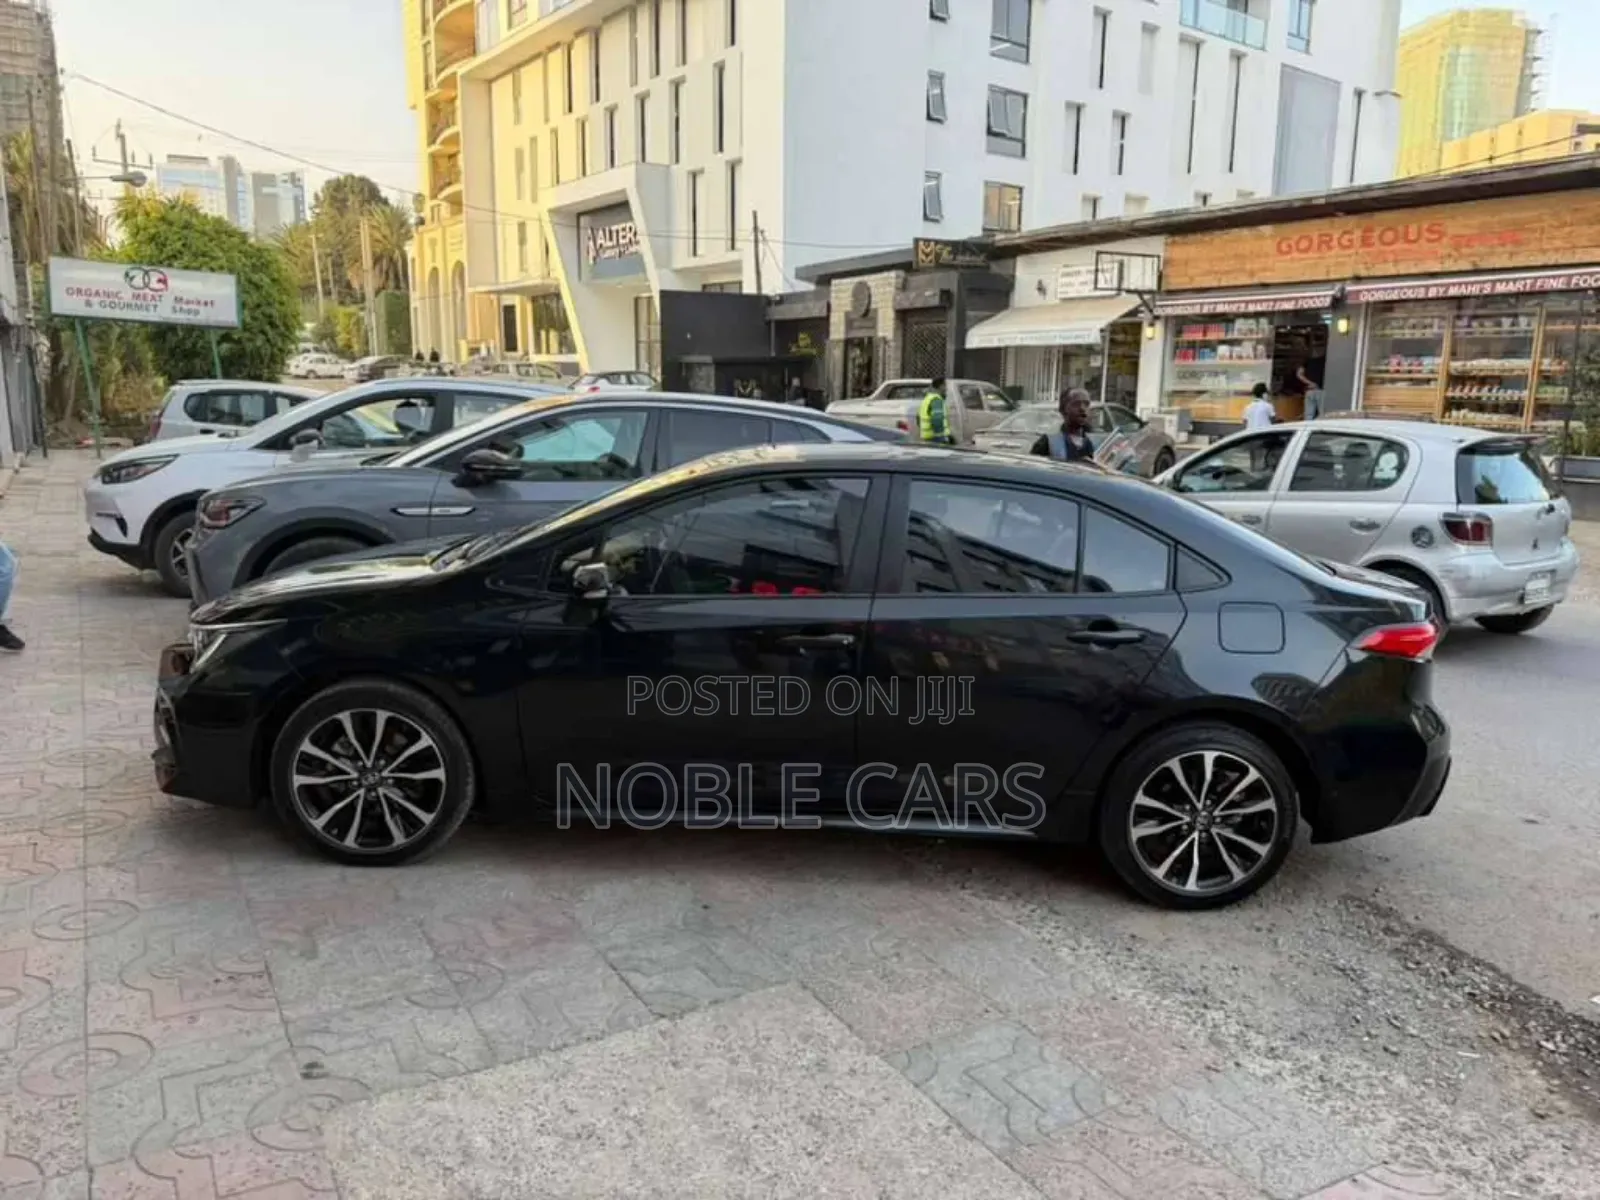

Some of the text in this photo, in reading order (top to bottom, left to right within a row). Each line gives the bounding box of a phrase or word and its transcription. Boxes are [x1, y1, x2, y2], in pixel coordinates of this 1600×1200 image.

[1276, 223, 1447, 256] GORGEOUS
[65, 287, 215, 308] ORGANIC MEAT Market
[1360, 287, 1425, 300] GORGEOUS
[1427, 285, 1446, 297] BY
[1448, 281, 1491, 296] MAHI'S
[1495, 278, 1533, 293] MART
[1535, 275, 1567, 290] FINE
[100, 299, 159, 313] GOURMET
[172, 306, 200, 316] Shop
